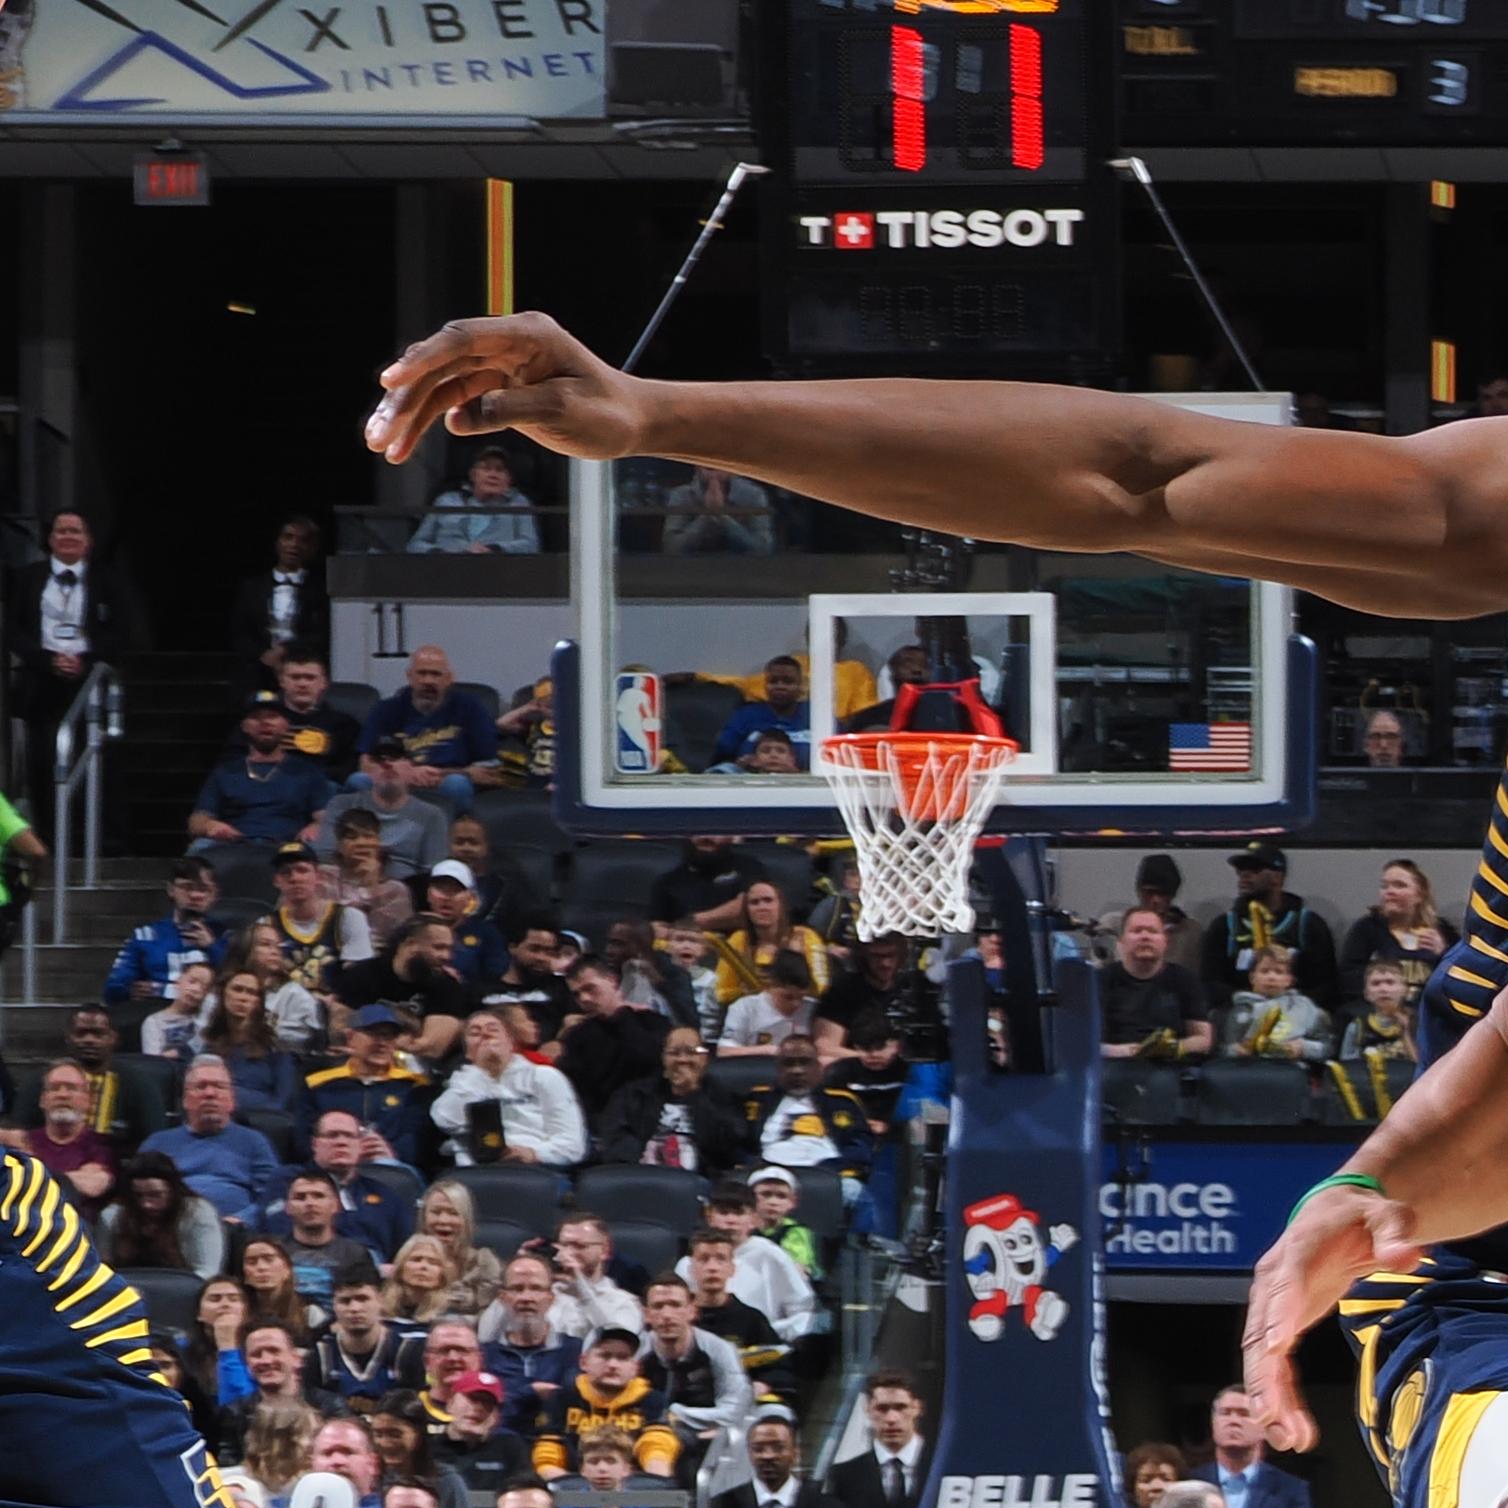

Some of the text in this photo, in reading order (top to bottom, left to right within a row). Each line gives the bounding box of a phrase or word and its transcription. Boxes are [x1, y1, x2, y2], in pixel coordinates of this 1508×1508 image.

[300, 0, 602, 52] XIBER
[340, 52, 596, 93] INTERNET
[1429, 59, 1469, 105] 3
[891, 23, 1044, 172] 11
[148, 163, 199, 198] EXIT
[876, 209, 1084, 249] TISSOT
[371, 602, 410, 658] 11
